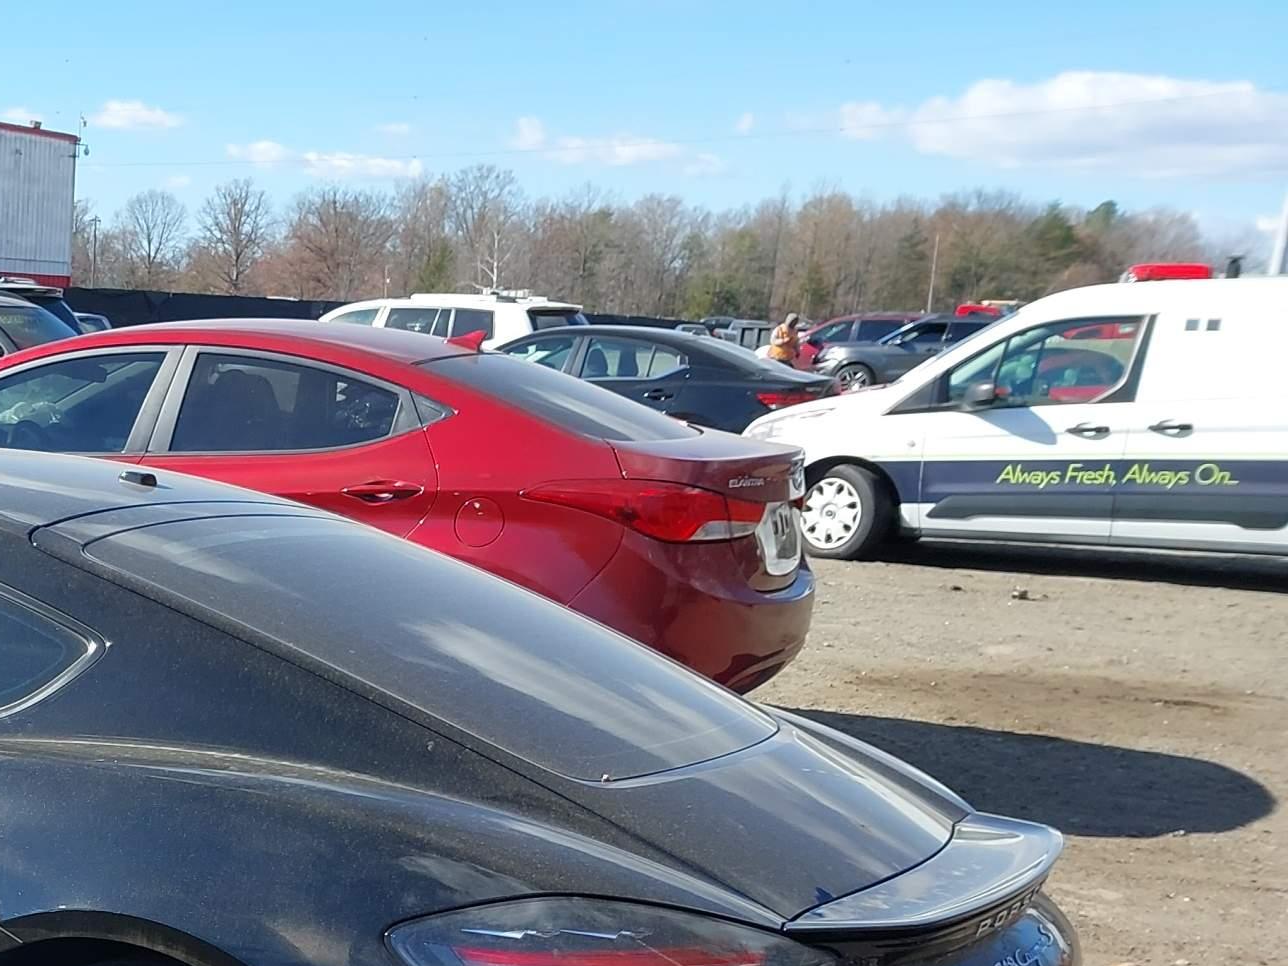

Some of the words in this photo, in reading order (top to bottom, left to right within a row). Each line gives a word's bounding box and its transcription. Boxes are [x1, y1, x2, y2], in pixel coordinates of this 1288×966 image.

[996, 463, 1061, 489] Always
[1064, 463, 1117, 488] Fresh,
[1121, 463, 1190, 489] Always
[1038, 923, 1054, 946] S
